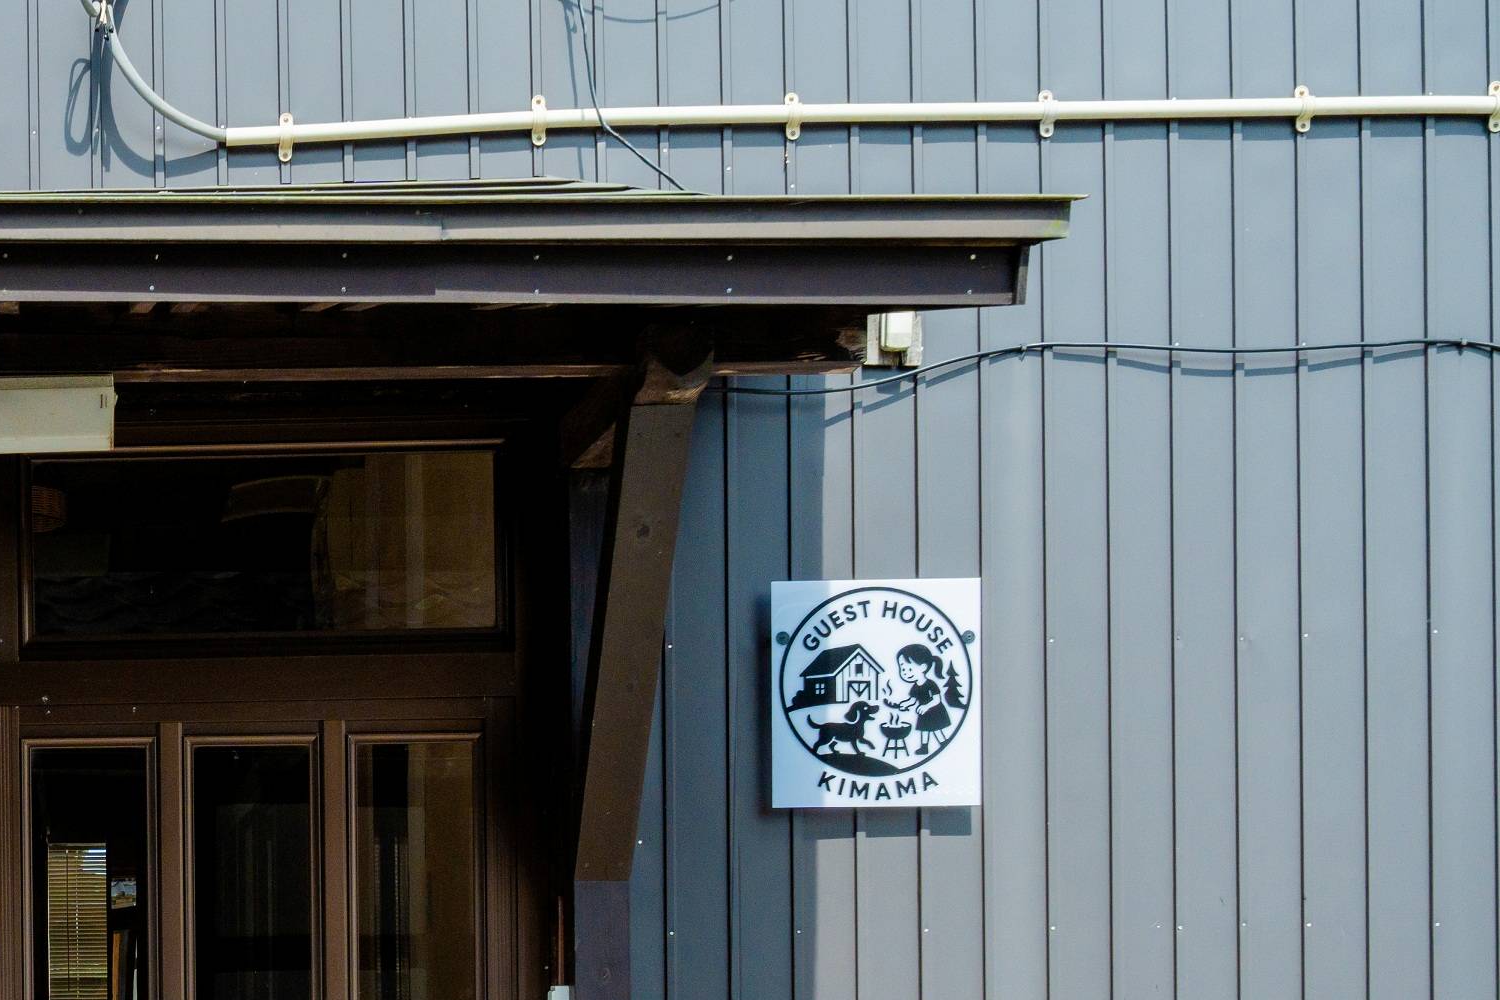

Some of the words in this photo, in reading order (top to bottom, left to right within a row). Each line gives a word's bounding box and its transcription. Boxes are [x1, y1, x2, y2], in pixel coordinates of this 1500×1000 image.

[803, 600, 871, 651] GUEST
[882, 600, 953, 655] HOUSE
[817, 771, 939, 801] KIMAMA
